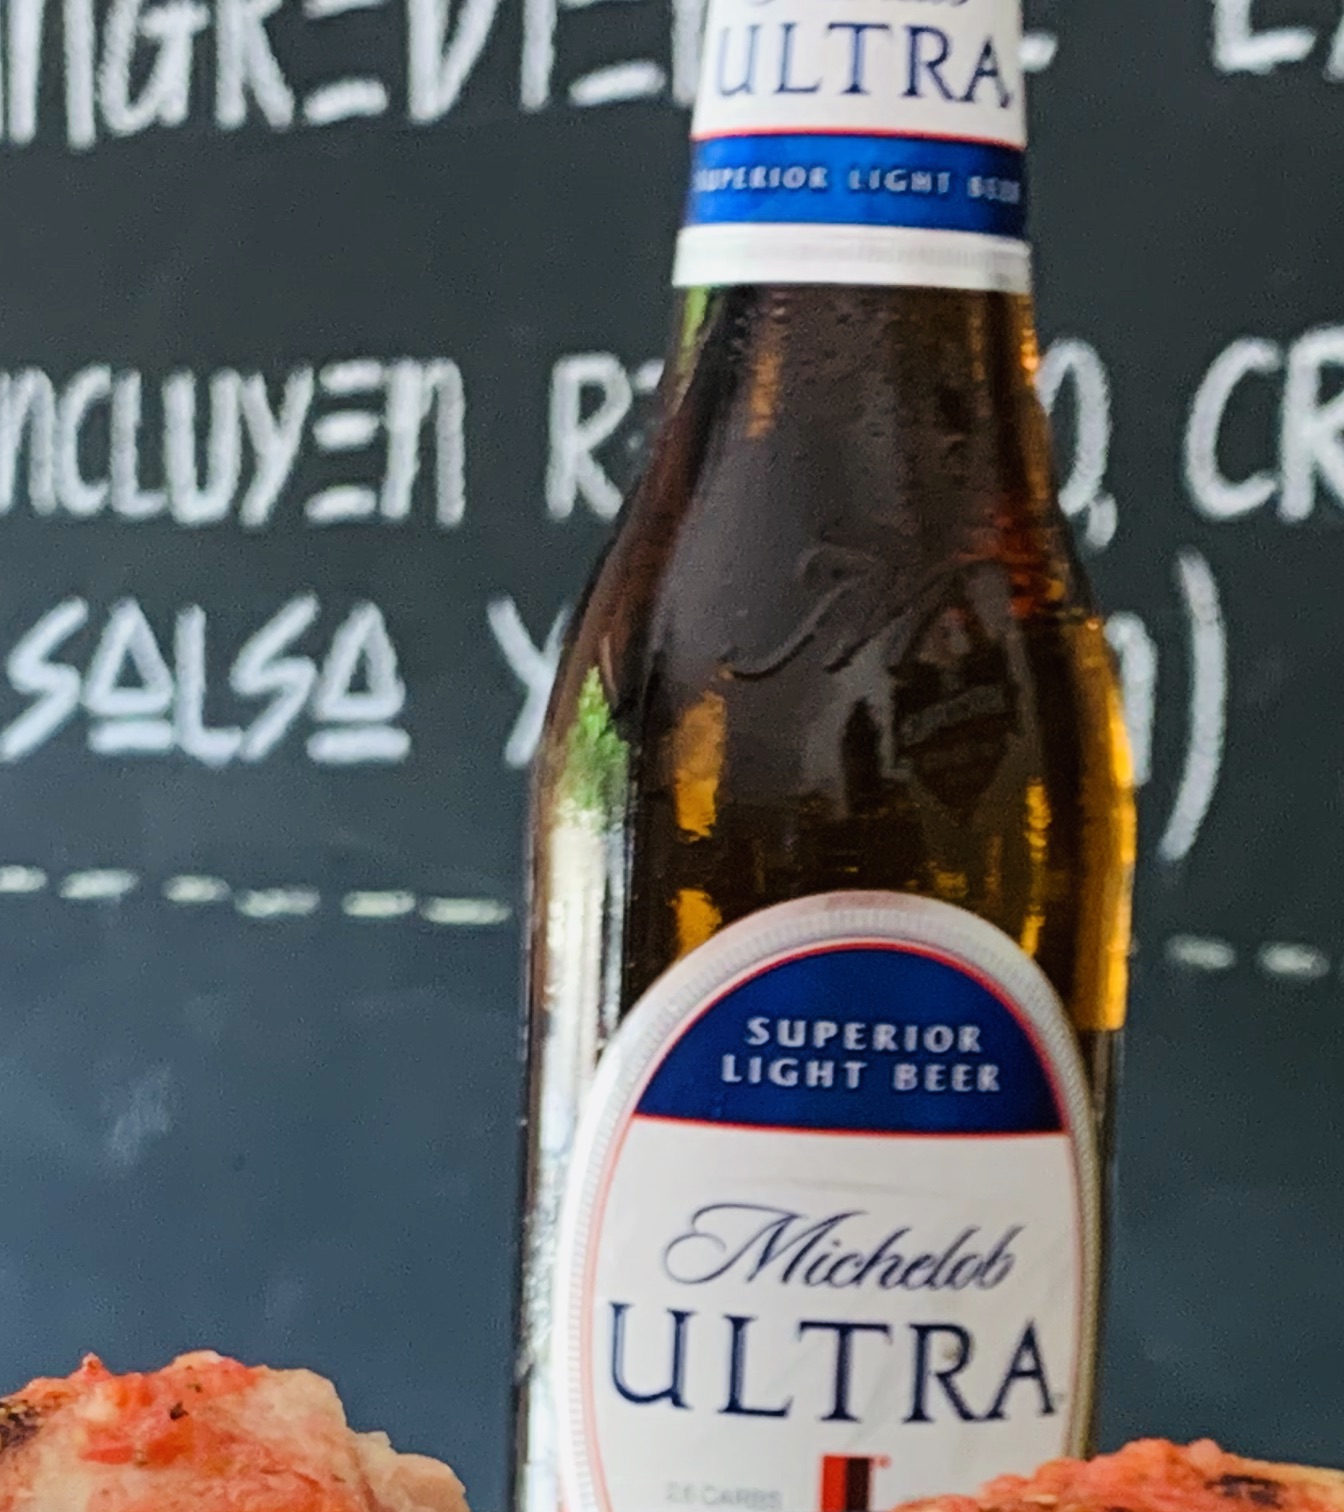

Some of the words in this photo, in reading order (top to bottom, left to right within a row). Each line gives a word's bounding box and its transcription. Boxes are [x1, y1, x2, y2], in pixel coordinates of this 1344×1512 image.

[716, 22, 1015, 109] ULTRA
[847, 168, 951, 195] LIGHT
[745, 1016, 983, 1055] SUPERIOR
[720, 1053, 867, 1091] LIGHT
[892, 1063, 1001, 1094] BEER
[663, 1202, 1028, 1292] Michelob
[607, 1301, 1058, 1426] ULTRA
